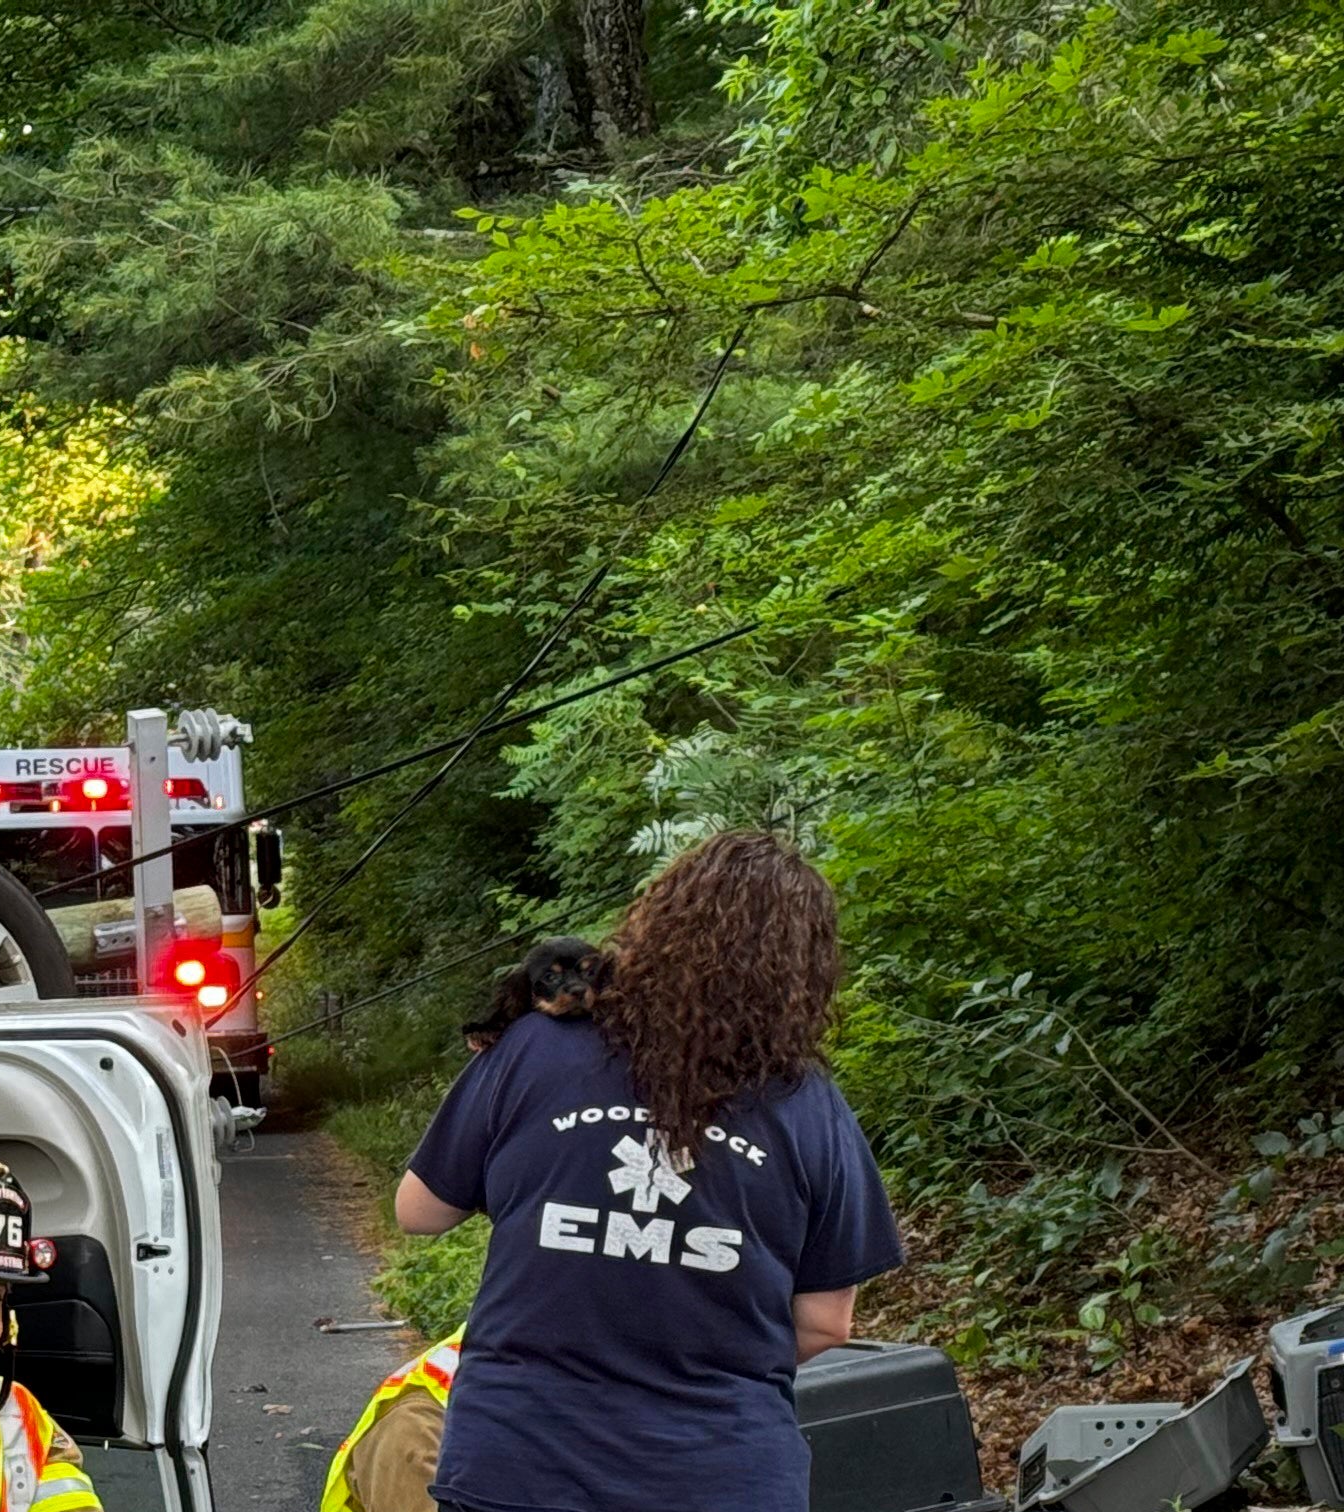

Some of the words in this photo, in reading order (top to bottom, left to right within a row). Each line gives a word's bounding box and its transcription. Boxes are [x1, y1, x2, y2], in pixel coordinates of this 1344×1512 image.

[16, 756, 116, 776] RESCUE
[552, 1106, 768, 1167] WOODOCK
[539, 1201, 743, 1273] EMS
